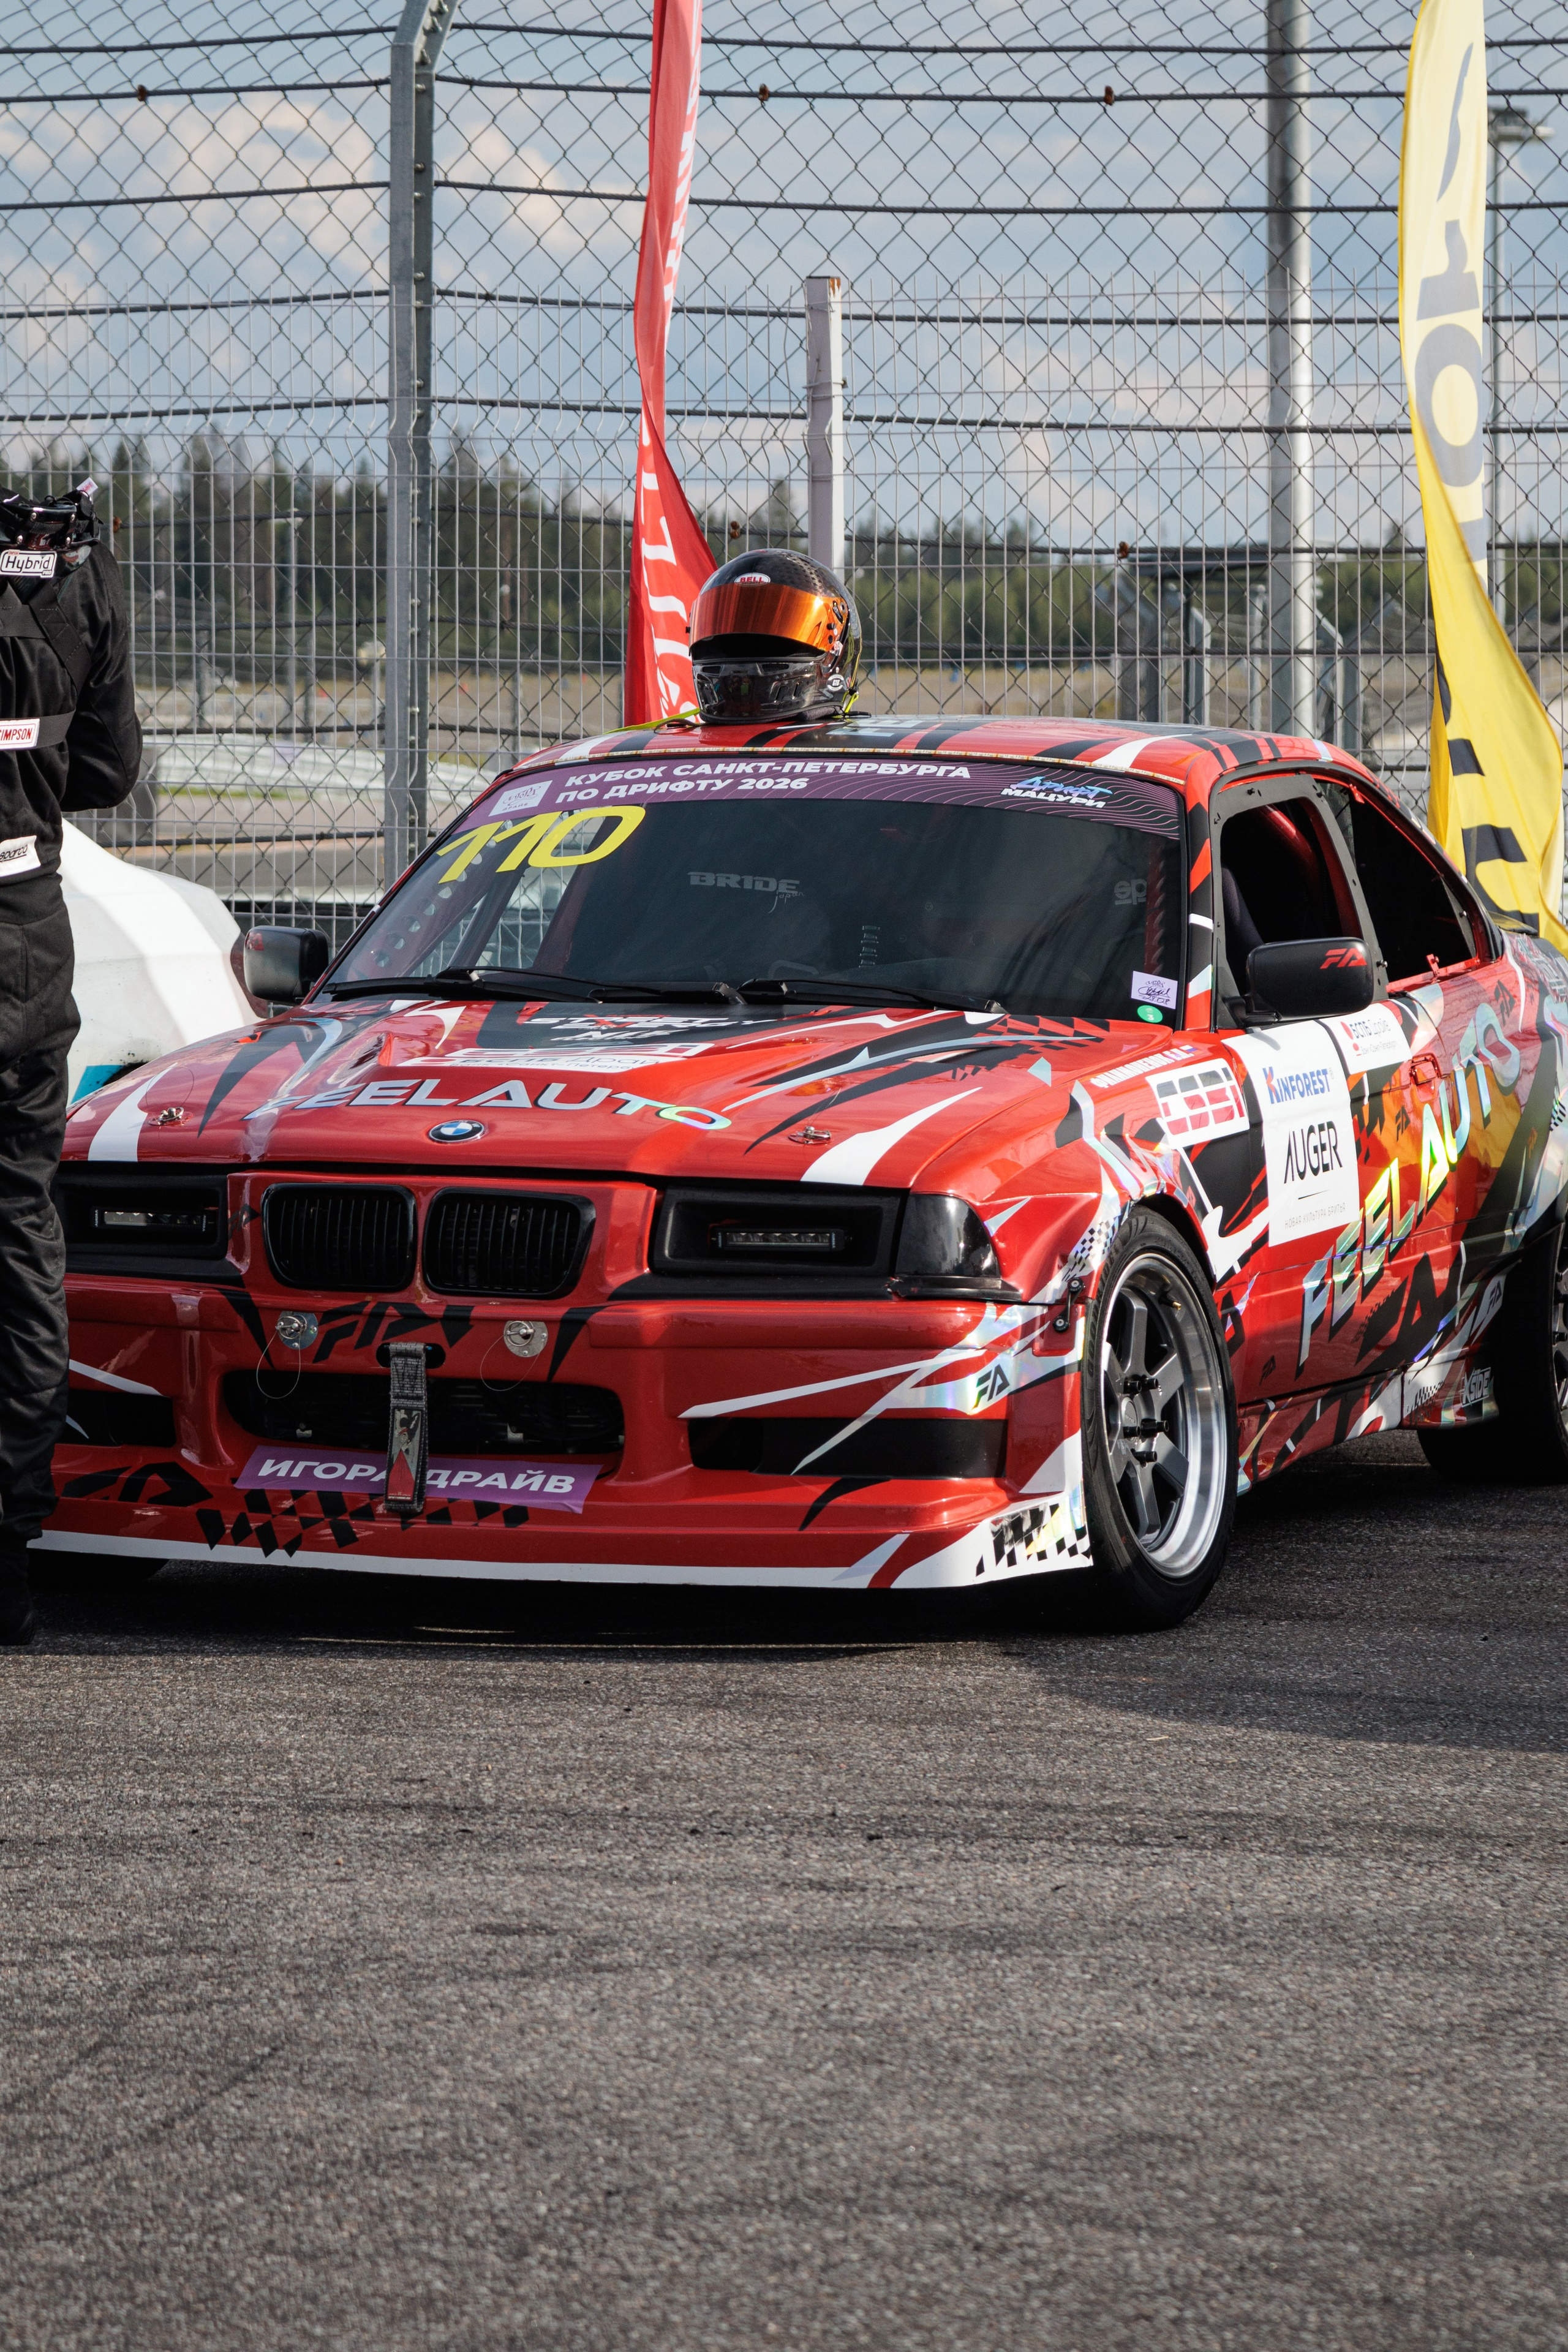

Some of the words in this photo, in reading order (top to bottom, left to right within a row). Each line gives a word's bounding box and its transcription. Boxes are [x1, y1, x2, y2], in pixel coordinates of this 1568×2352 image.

[6, 556, 51, 572] Hybrid
[0, 728, 32, 741] IMPSON
[565, 766, 668, 787] КУБОК
[673, 761, 971, 778] САНКТ-ПЕТЕРБУРГА
[556, 788, 600, 804] ПО
[603, 780, 733, 801] ДРИФТУ
[737, 777, 810, 790] 2026
[1000, 788, 1106, 809] МАЦУРИ
[502, 802, 529, 812] ДРАЙВ
[436, 805, 646, 884] 110
[688, 872, 800, 894] BRIDE
[1349, 1021, 1372, 1039] БСПБ
[1262, 1066, 1330, 1104] KINFOREST
[243, 1079, 732, 1130] FEELAUTO
[1284, 1120, 1343, 1185] AUGER
[1298, 1003, 1520, 1366] FEELAUTO
[1284, 1215, 1302, 1229] НОВАЯ
[1303, 1208, 1327, 1224] КУЛЬТУРА
[1328, 1202, 1346, 1216] БРИТЬЯ
[426, 1469, 576, 1493] ДРАЙВ
